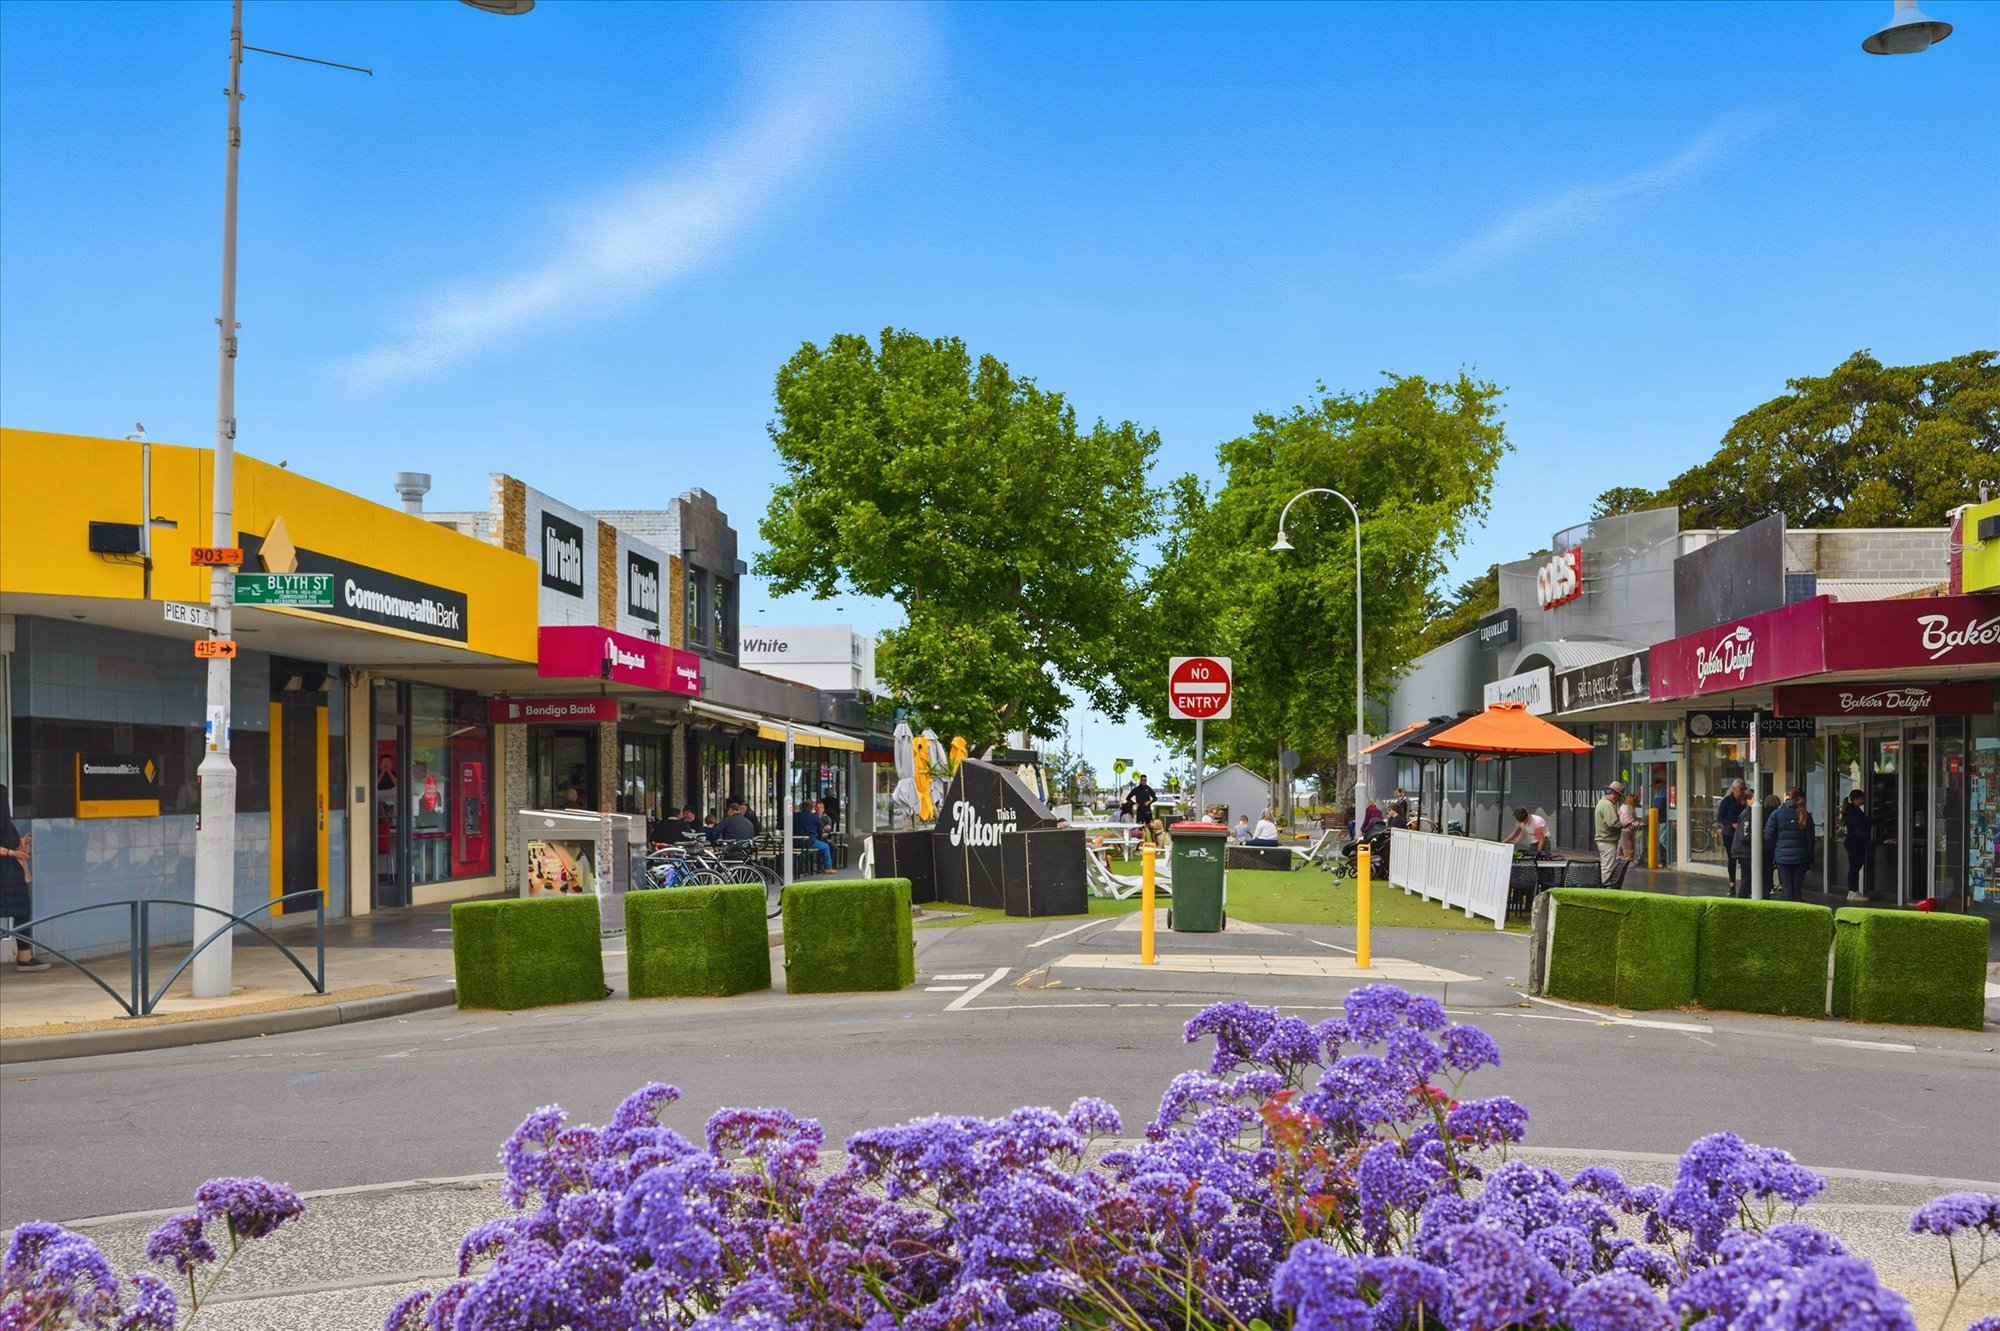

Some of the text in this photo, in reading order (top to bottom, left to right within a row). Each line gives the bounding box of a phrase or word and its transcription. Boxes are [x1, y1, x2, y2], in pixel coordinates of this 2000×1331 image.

[195, 550, 223, 562] 903
[267, 576, 329, 591] BLYTH ST
[166, 603, 202, 624] PIER ST
[1480, 620, 1509, 642] LIQUORLAND
[197, 642, 217, 654] 415
[743, 639, 788, 653] White
[1696, 640, 1755, 688] Bakers Delight
[1191, 667, 1210, 680] NO
[1178, 696, 1222, 709] ENTRY
[1839, 693, 1932, 713] Bakers Delight
[525, 704, 597, 718] Bendigo Bank
[1714, 715, 1737, 731] salt
[1760, 719, 1783, 733] epa
[1786, 716, 1814, 731] café
[996, 807, 1017, 820] This is
